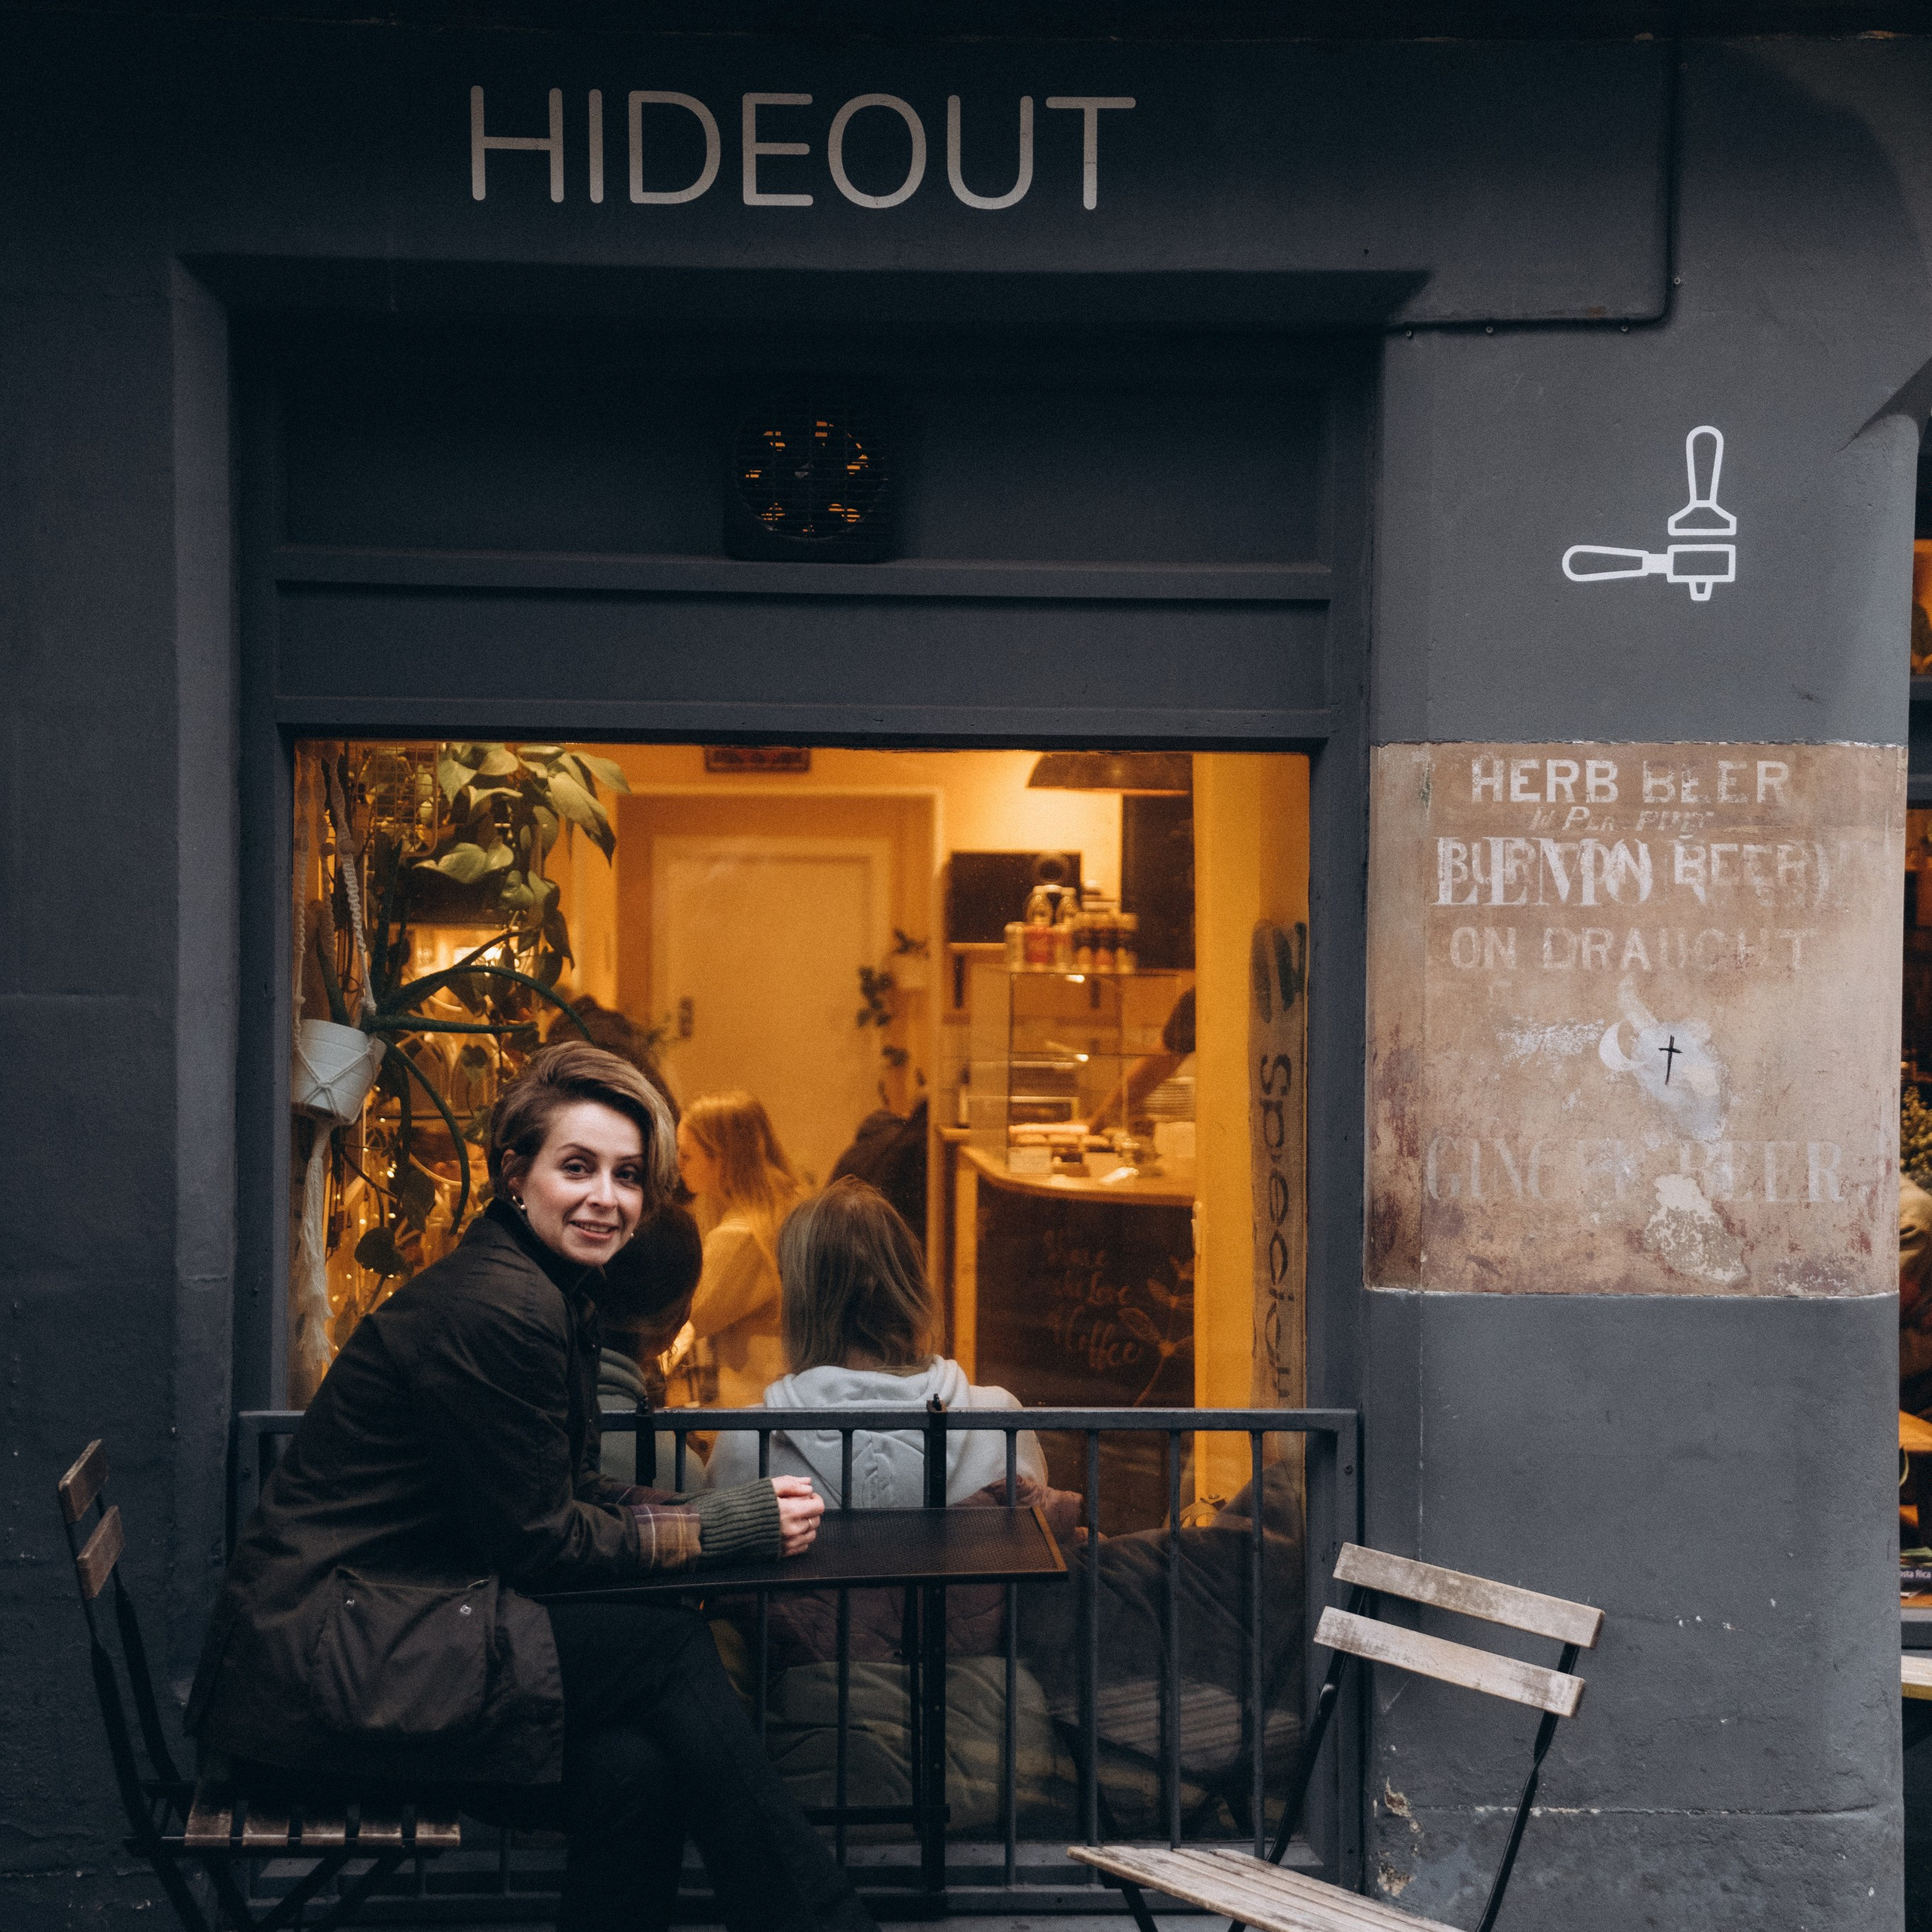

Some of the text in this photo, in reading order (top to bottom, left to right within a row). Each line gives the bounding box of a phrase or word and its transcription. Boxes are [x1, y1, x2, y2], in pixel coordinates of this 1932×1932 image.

[470, 85, 1137, 211] HIDEOUT
[1470, 758, 1791, 805] HERB BEER
[1449, 926, 1516, 971] ON
